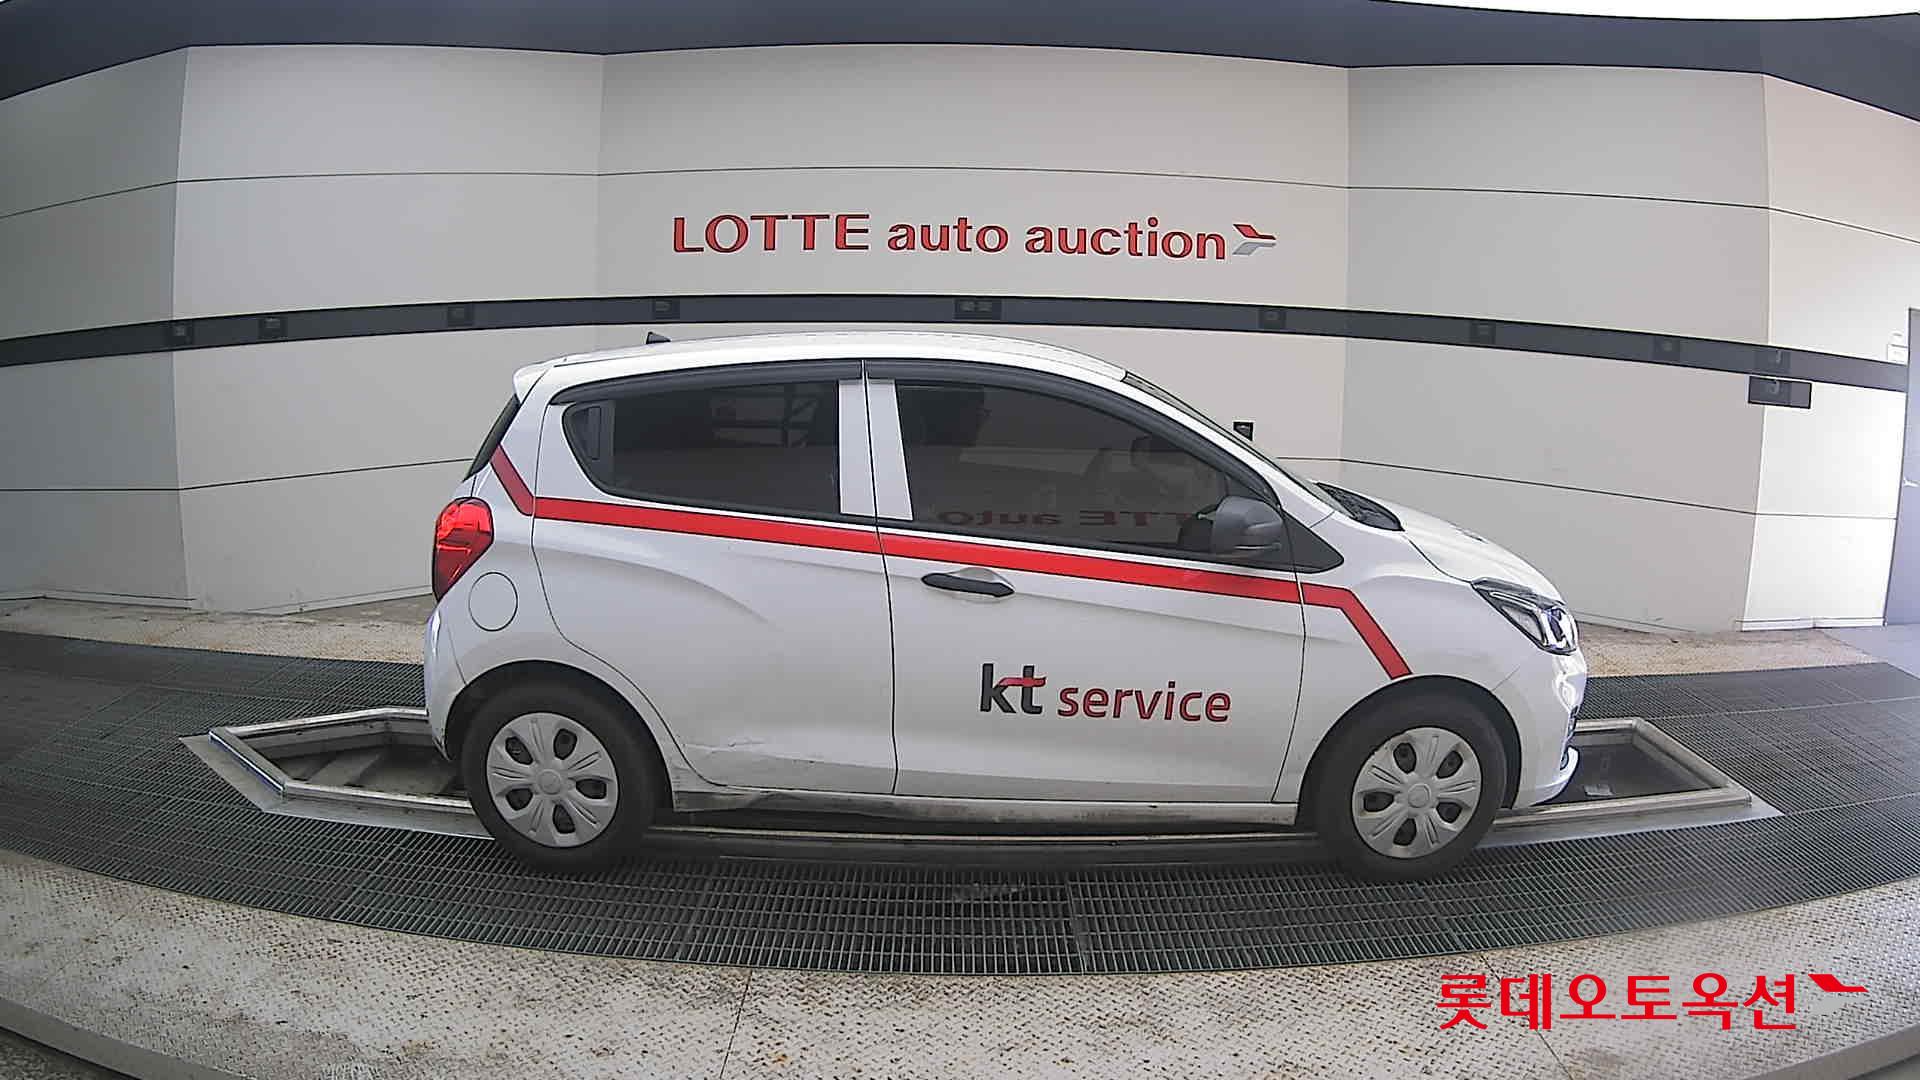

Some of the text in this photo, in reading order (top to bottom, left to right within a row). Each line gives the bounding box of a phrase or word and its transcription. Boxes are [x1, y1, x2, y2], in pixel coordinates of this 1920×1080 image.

[673, 213, 1226, 260] LOTTE auto auction
[979, 662, 1231, 723] kt service
